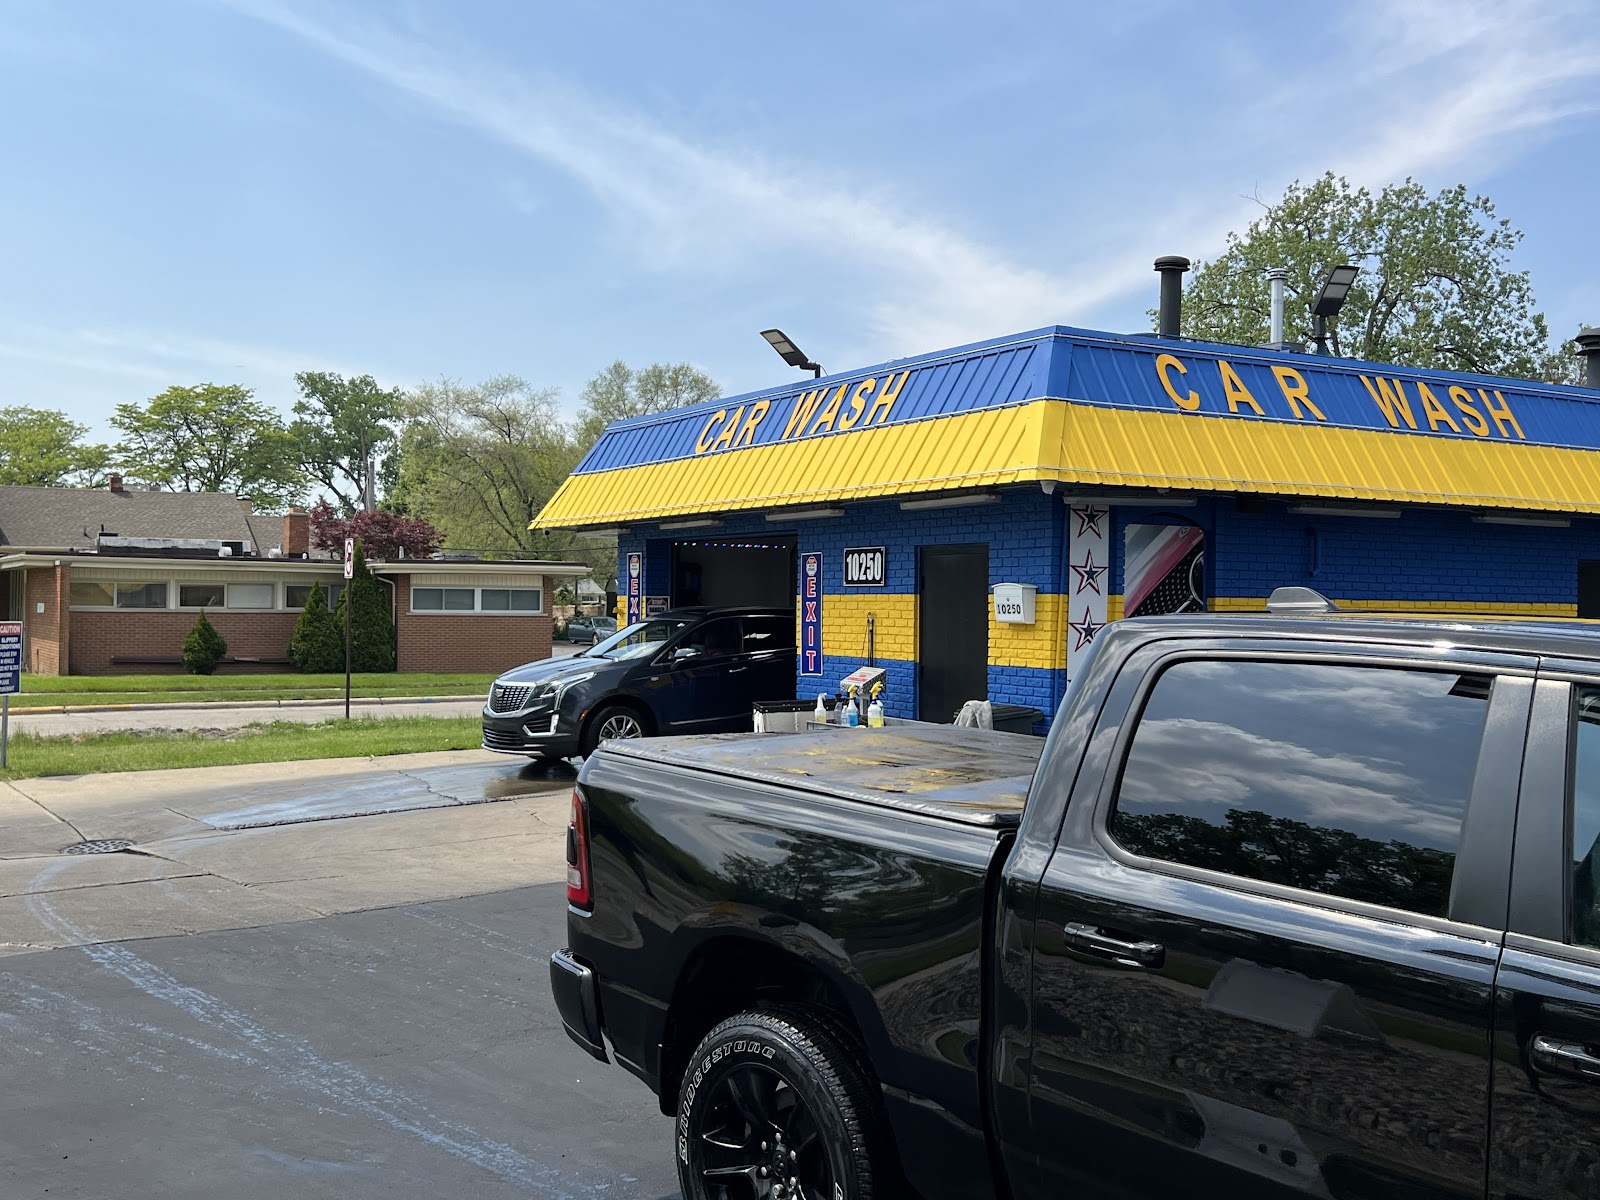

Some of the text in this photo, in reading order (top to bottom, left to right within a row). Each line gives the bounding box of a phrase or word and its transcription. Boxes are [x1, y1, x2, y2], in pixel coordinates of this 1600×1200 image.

[695, 370, 911, 455] CAR WASH
[1155, 353, 1526, 440] CAR WASH
[847, 552, 882, 581] 10250
[0, 625, 20, 633] CAUTION
[806, 577, 817, 671] EXIT
[997, 604, 1021, 615] 10250
[679, 1040, 776, 1165] BRIDGESTONE
